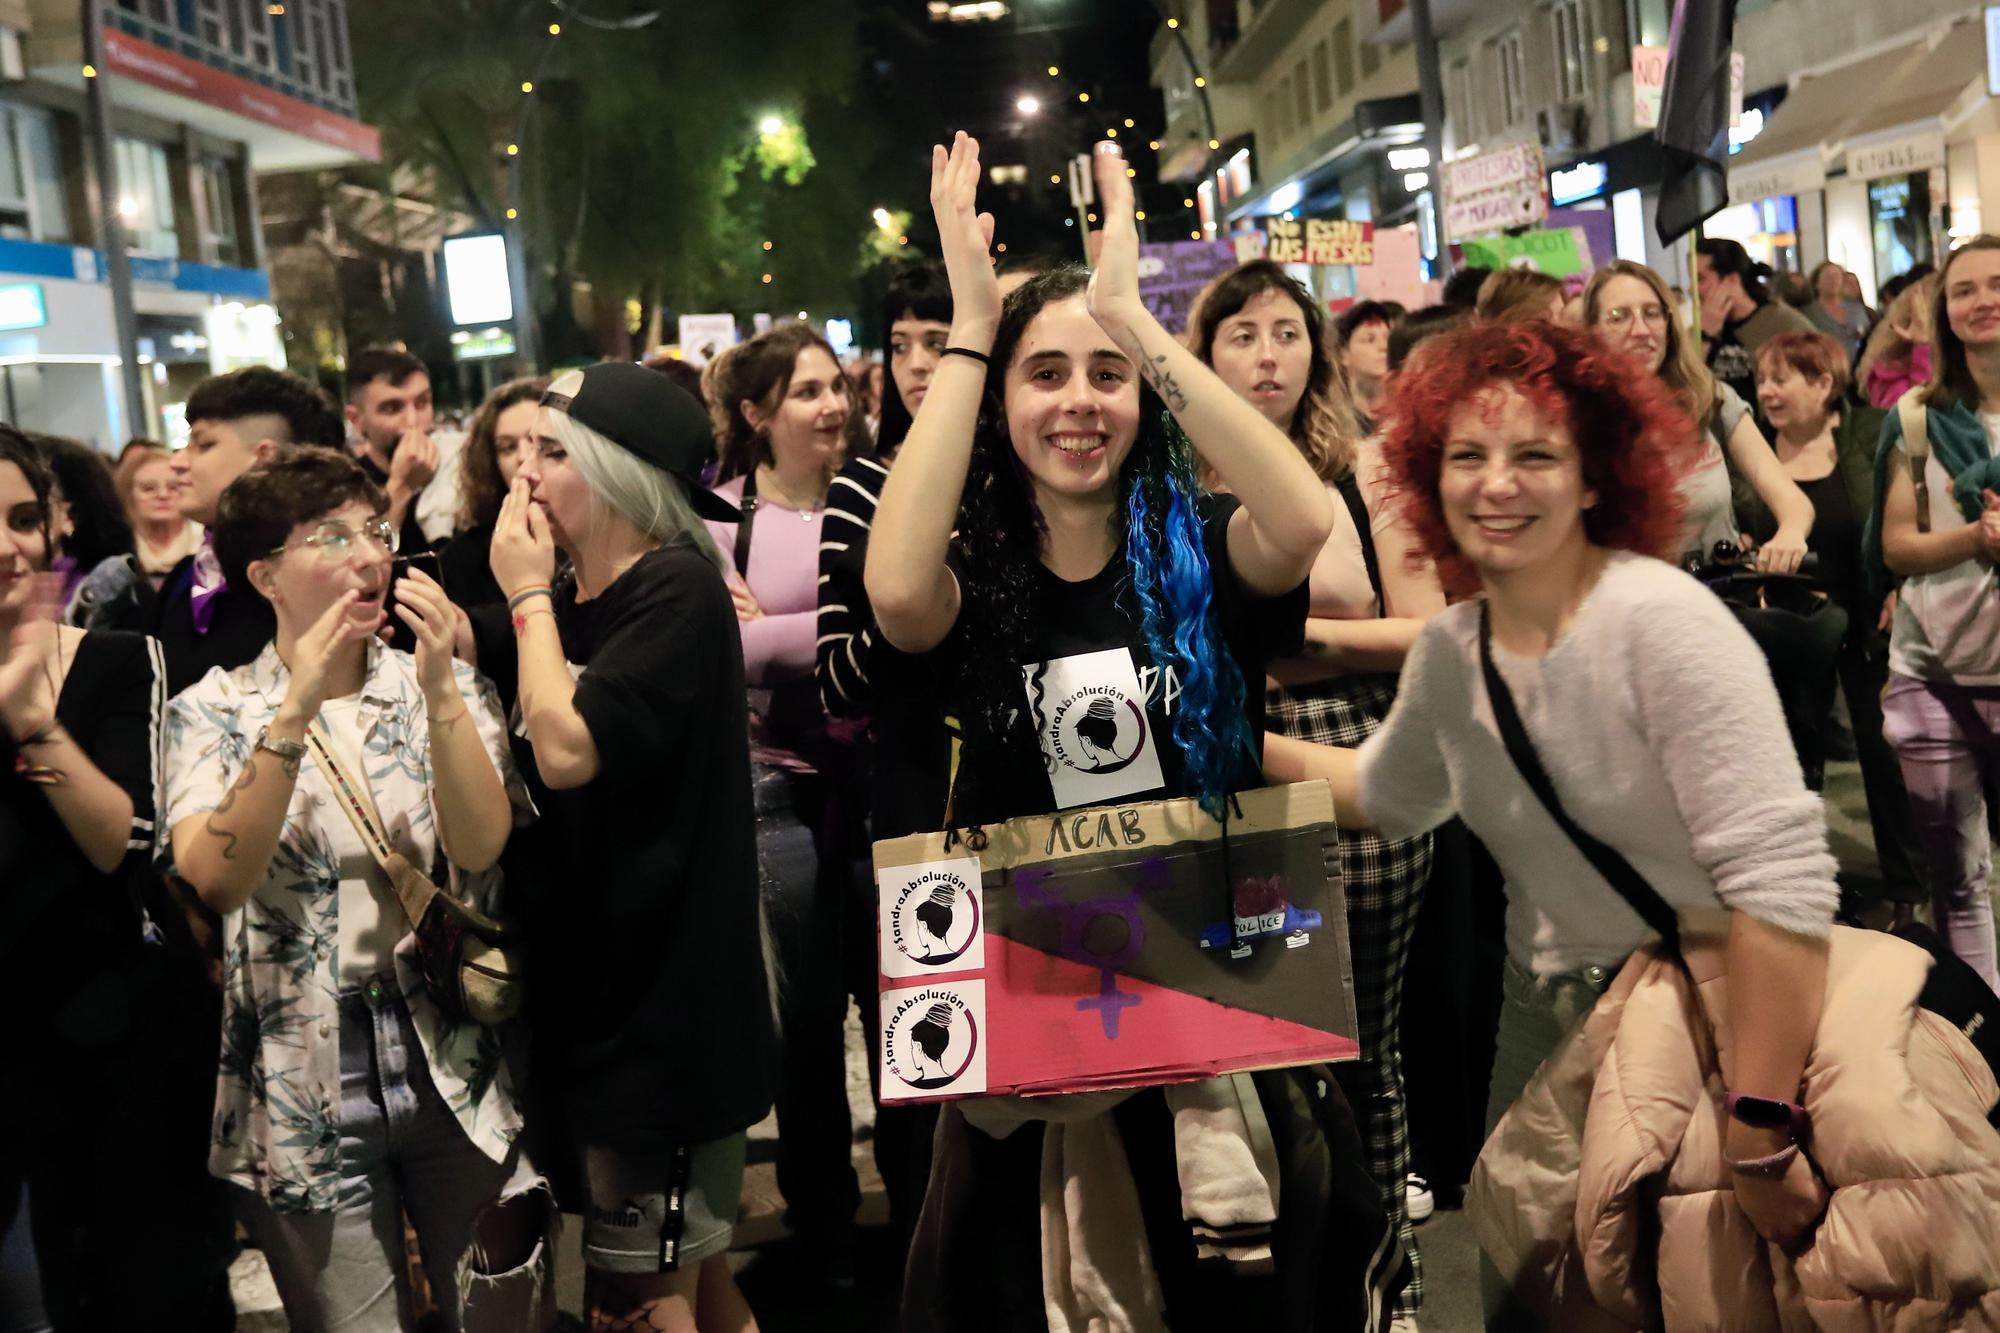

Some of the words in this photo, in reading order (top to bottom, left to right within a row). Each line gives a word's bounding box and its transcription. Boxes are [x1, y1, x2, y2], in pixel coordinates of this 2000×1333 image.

[1049, 684, 1125, 768] #SandraAbsolución
[1045, 809, 1146, 855] ACAB
[890, 871, 967, 954] #SandraAbsolución
[884, 988, 965, 1076] #SandraAbsolución
